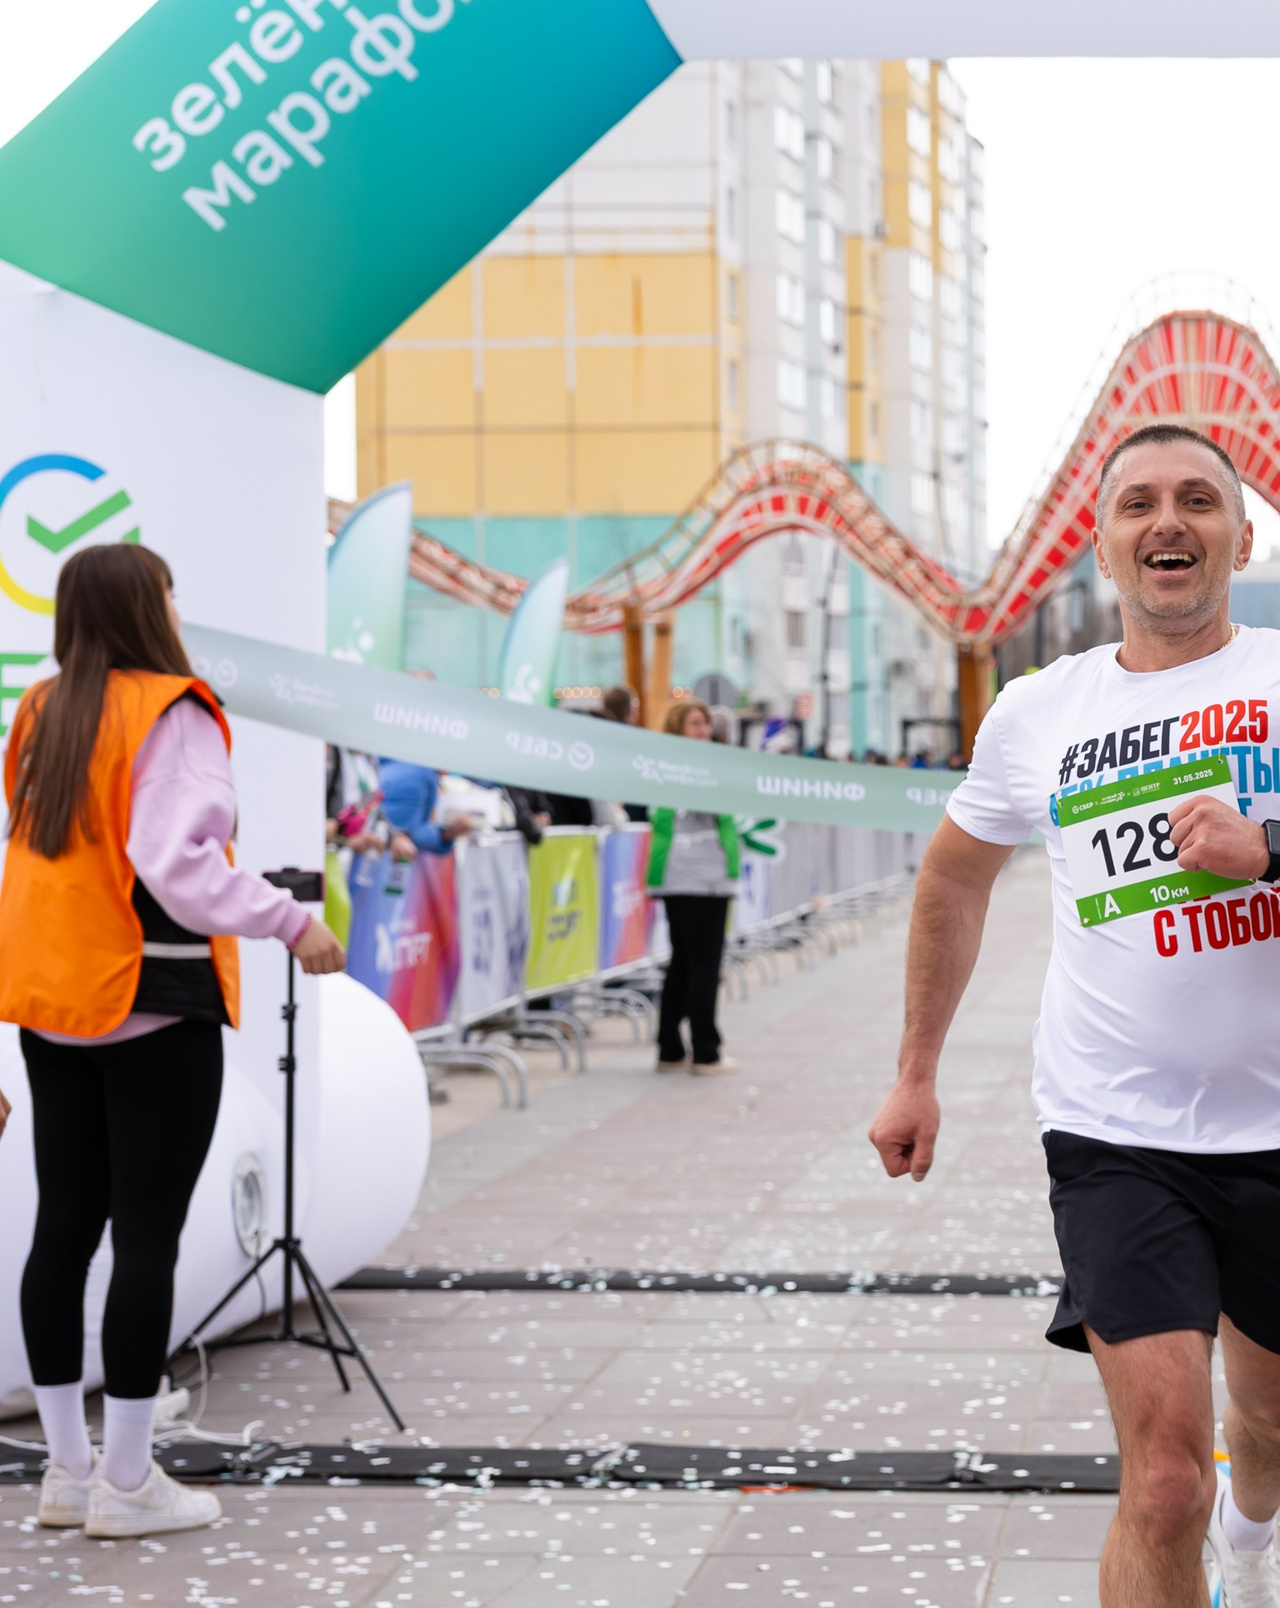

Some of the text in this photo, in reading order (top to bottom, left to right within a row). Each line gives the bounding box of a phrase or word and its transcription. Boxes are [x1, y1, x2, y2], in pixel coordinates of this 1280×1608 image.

[181, 0, 472, 232] марафо
[1058, 699, 1269, 787] #ЗАБЕГ2025
[1173, 769, 1214, 785] 31.05.2025
[1079, 802, 1094, 811] СБЕР
[1104, 893, 1122, 918] А
[1153, 909, 1179, 958] С
